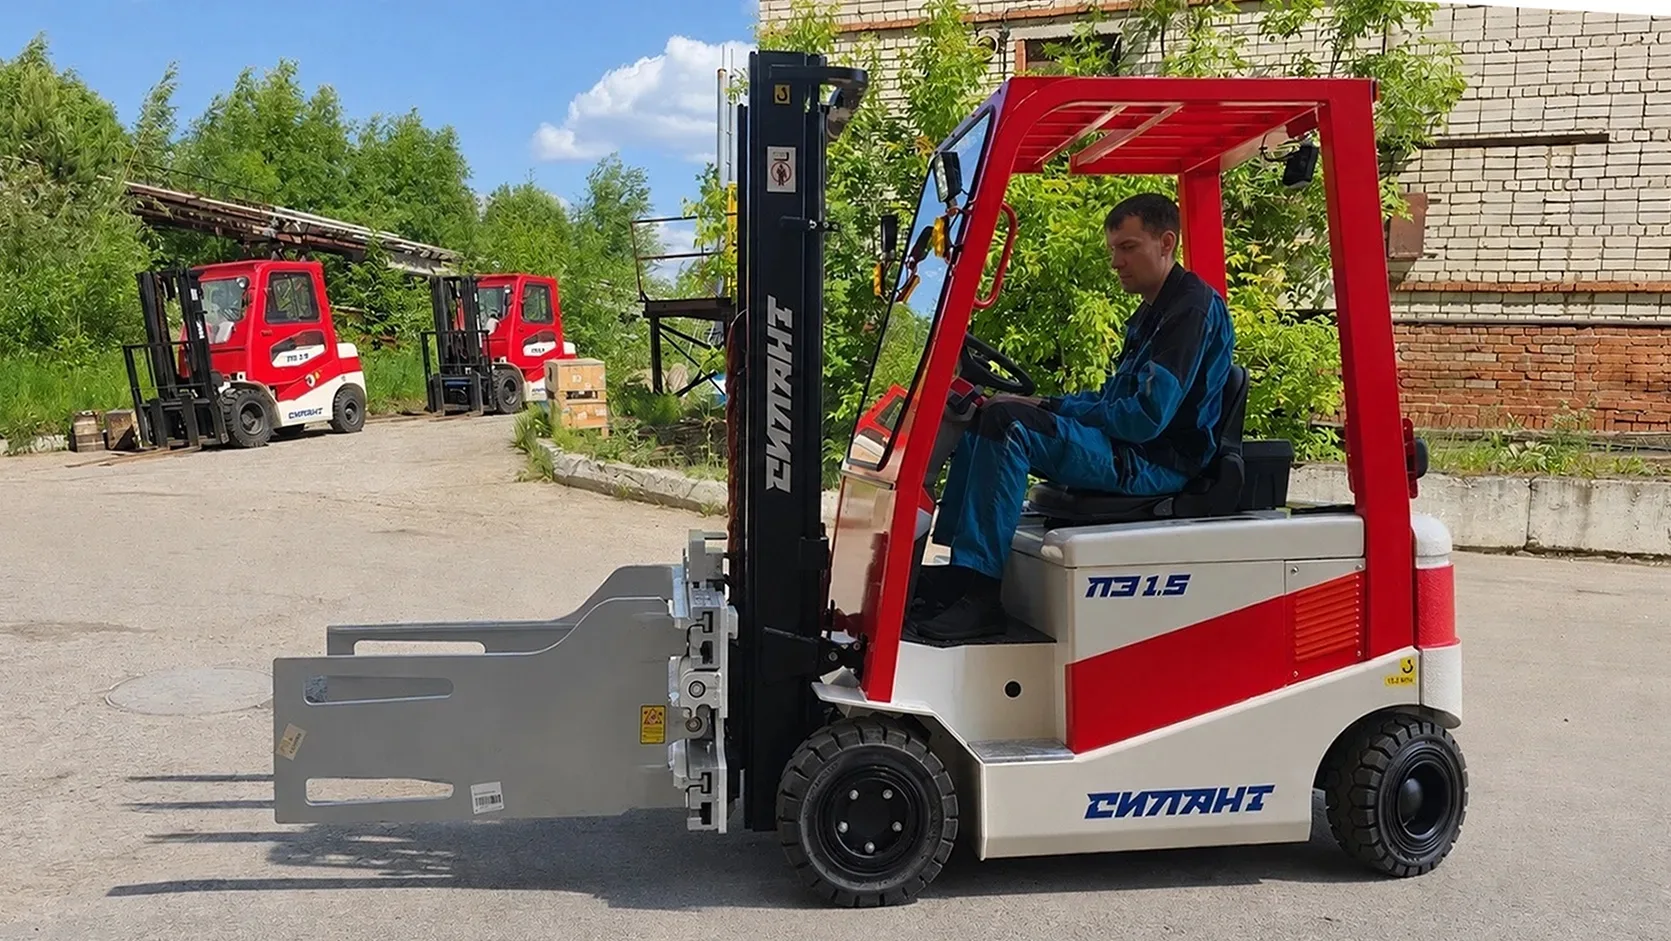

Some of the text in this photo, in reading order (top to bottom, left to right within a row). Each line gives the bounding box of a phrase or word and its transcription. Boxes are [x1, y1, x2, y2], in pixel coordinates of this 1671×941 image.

[767, 295, 793, 492] СИЛАНТ
[1085, 575, 1141, 598] ПЭ
[1085, 785, 1275, 819] СИЛАНТ
